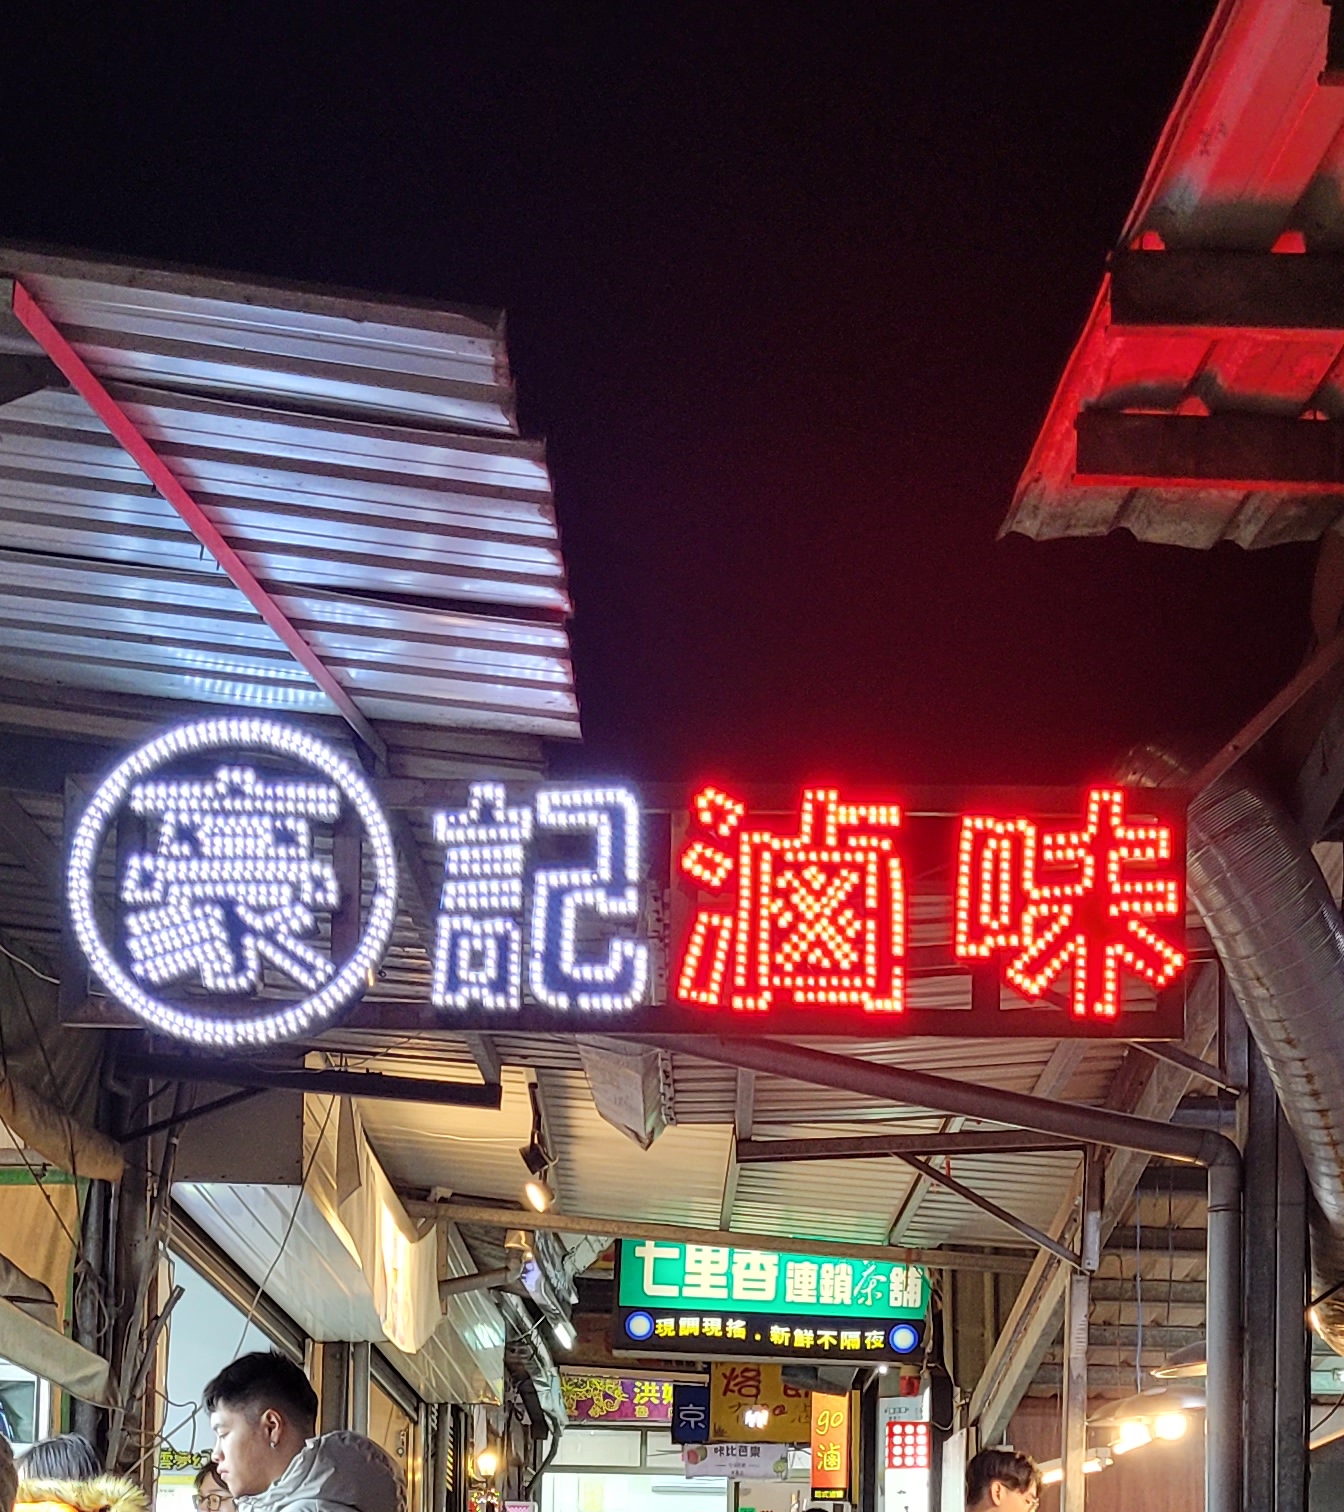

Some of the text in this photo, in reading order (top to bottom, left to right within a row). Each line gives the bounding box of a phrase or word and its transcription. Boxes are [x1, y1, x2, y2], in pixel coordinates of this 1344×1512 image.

[118, 764, 1188, 1018] 豪記滷味
[678, 1405, 707, 1430] 京
